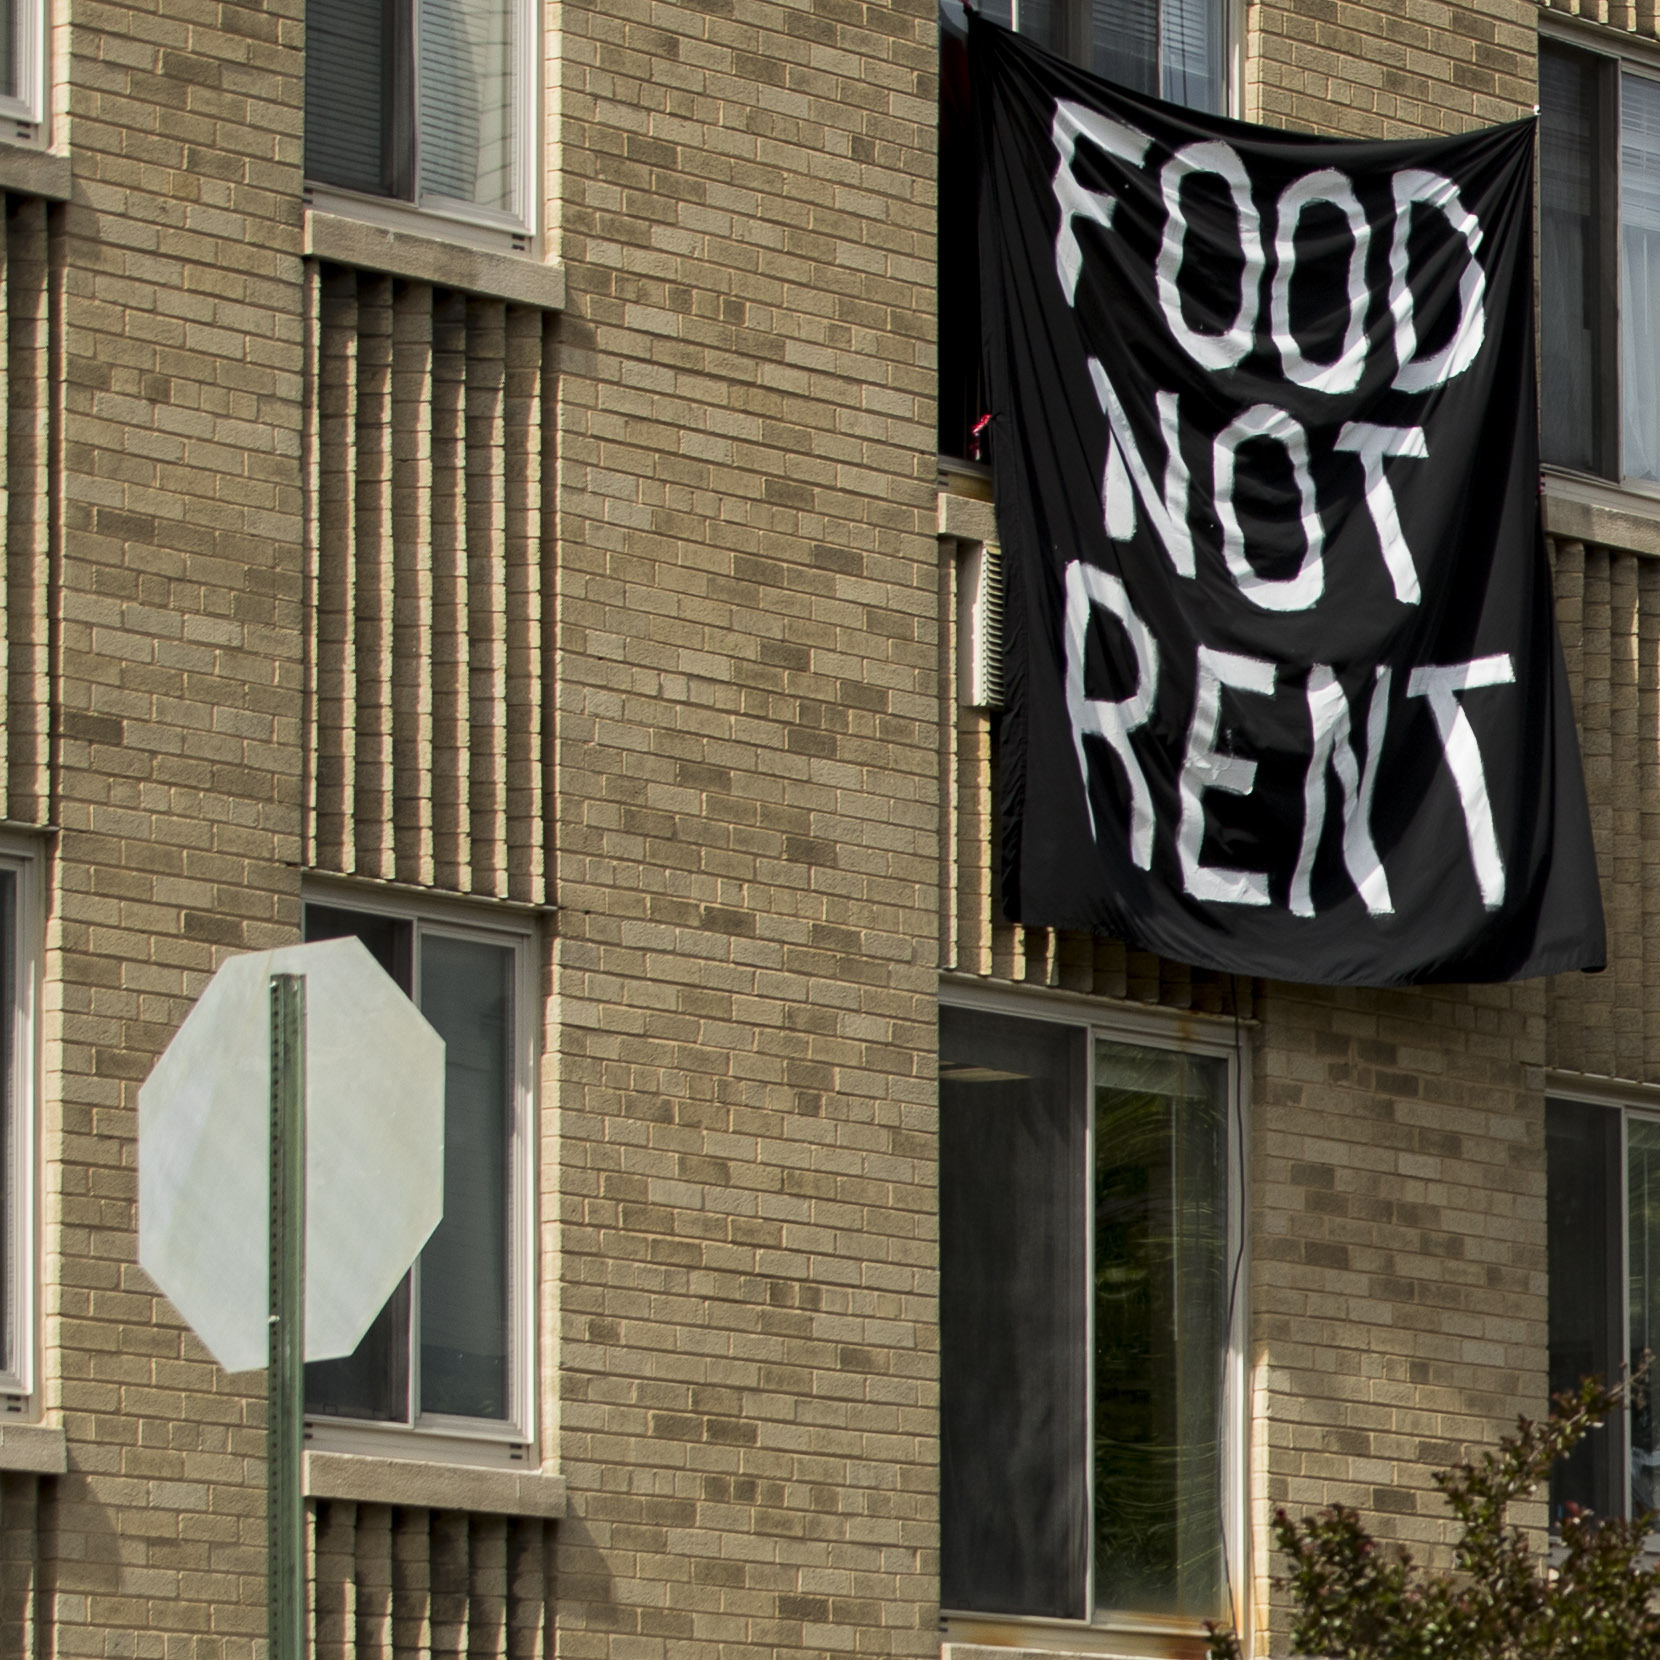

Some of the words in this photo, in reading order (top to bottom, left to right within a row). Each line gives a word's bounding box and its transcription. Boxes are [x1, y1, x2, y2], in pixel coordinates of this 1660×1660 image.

[1052, 97, 1486, 395] FOOD
[1087, 358, 1429, 612] NOT
[1062, 559, 1515, 918] RENT
